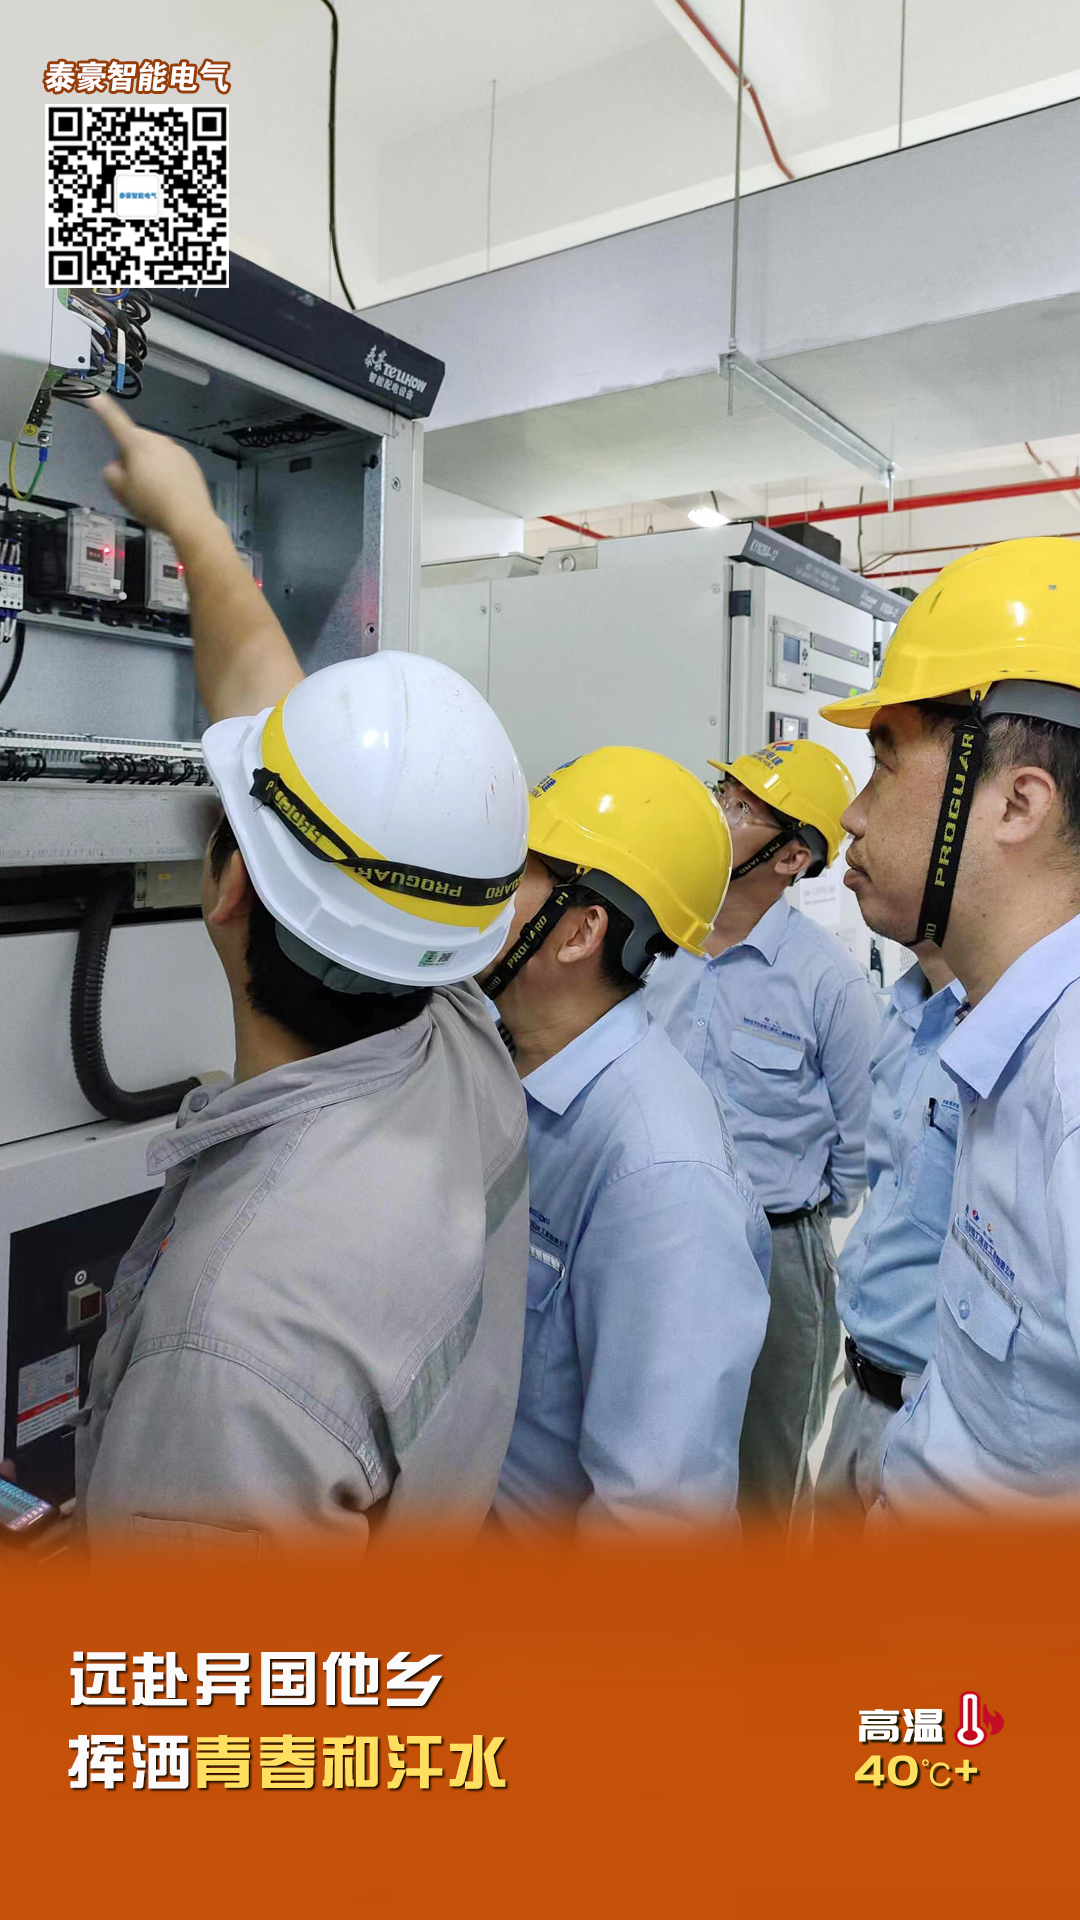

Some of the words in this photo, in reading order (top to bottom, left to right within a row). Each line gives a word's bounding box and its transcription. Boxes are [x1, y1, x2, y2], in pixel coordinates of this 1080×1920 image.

[368, 371, 414, 401] 智能配电设备
